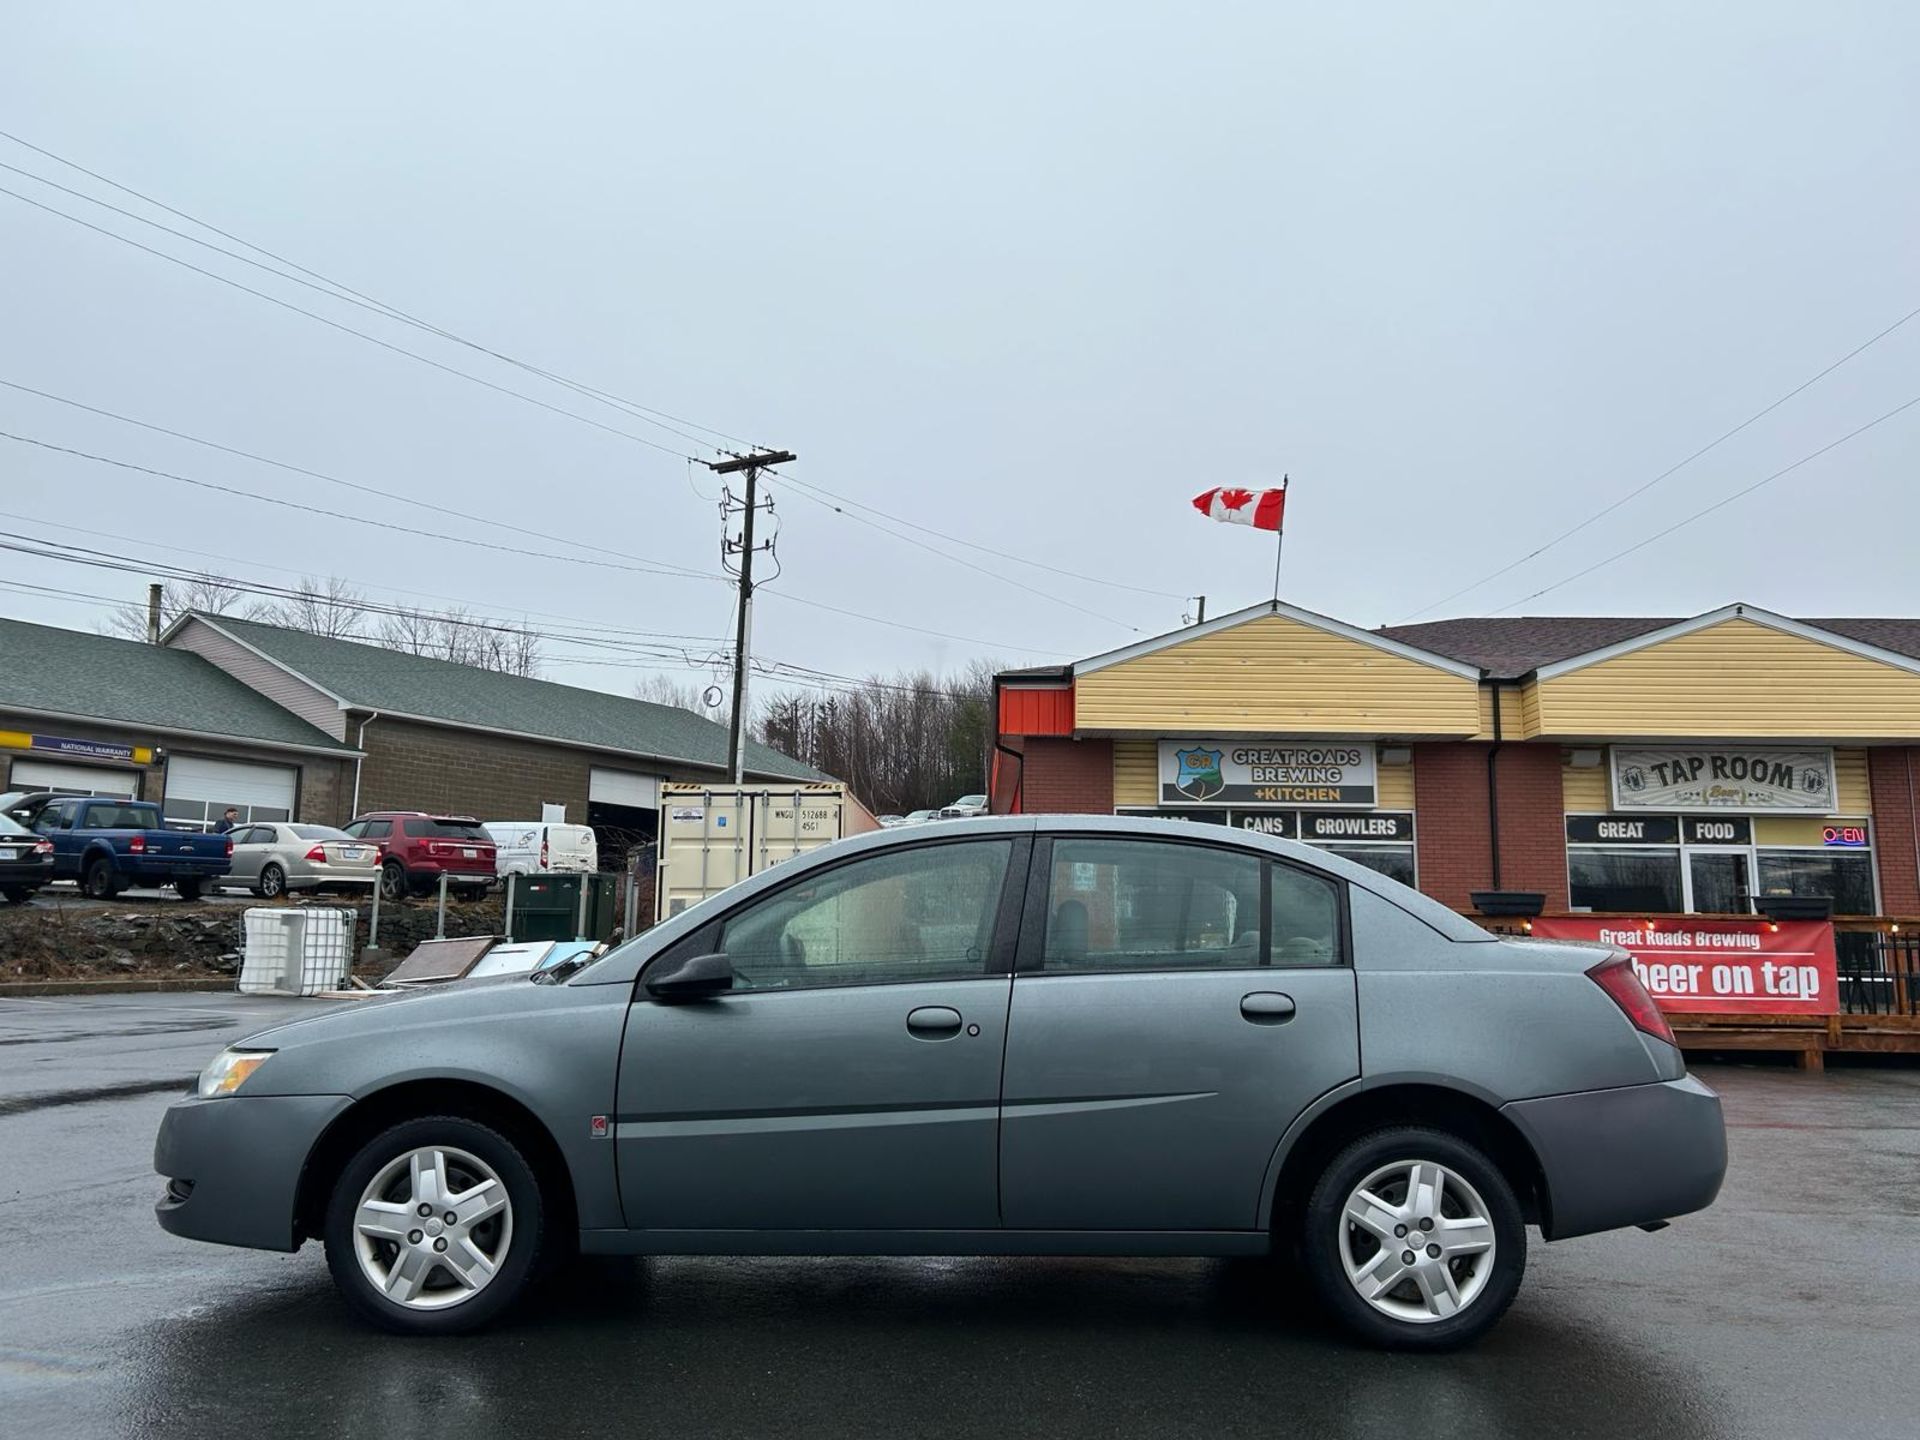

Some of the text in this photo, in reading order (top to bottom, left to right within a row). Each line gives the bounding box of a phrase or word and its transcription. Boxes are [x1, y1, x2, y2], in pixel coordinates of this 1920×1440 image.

[61, 742, 131, 757] NATIONAL WARRANTY
[1232, 749, 1361, 767] GREAT ROADS
[1252, 766, 1342, 784] BREWING
[1651, 755, 1794, 789] TAP ROOM
[1255, 787, 1341, 801] +KITCHEN
[802, 810, 828, 820] 512688
[1243, 816, 1283, 834] CANS
[1315, 818, 1397, 836] GROWLERS
[1598, 822, 1644, 838] GREAT
[1696, 823, 1734, 840] FOOD
[1823, 827, 1865, 842] OPEN
[1600, 929, 1761, 950] Great Roads Brewing
[1712, 964, 1754, 994] on
[1761, 961, 1819, 999] tap
